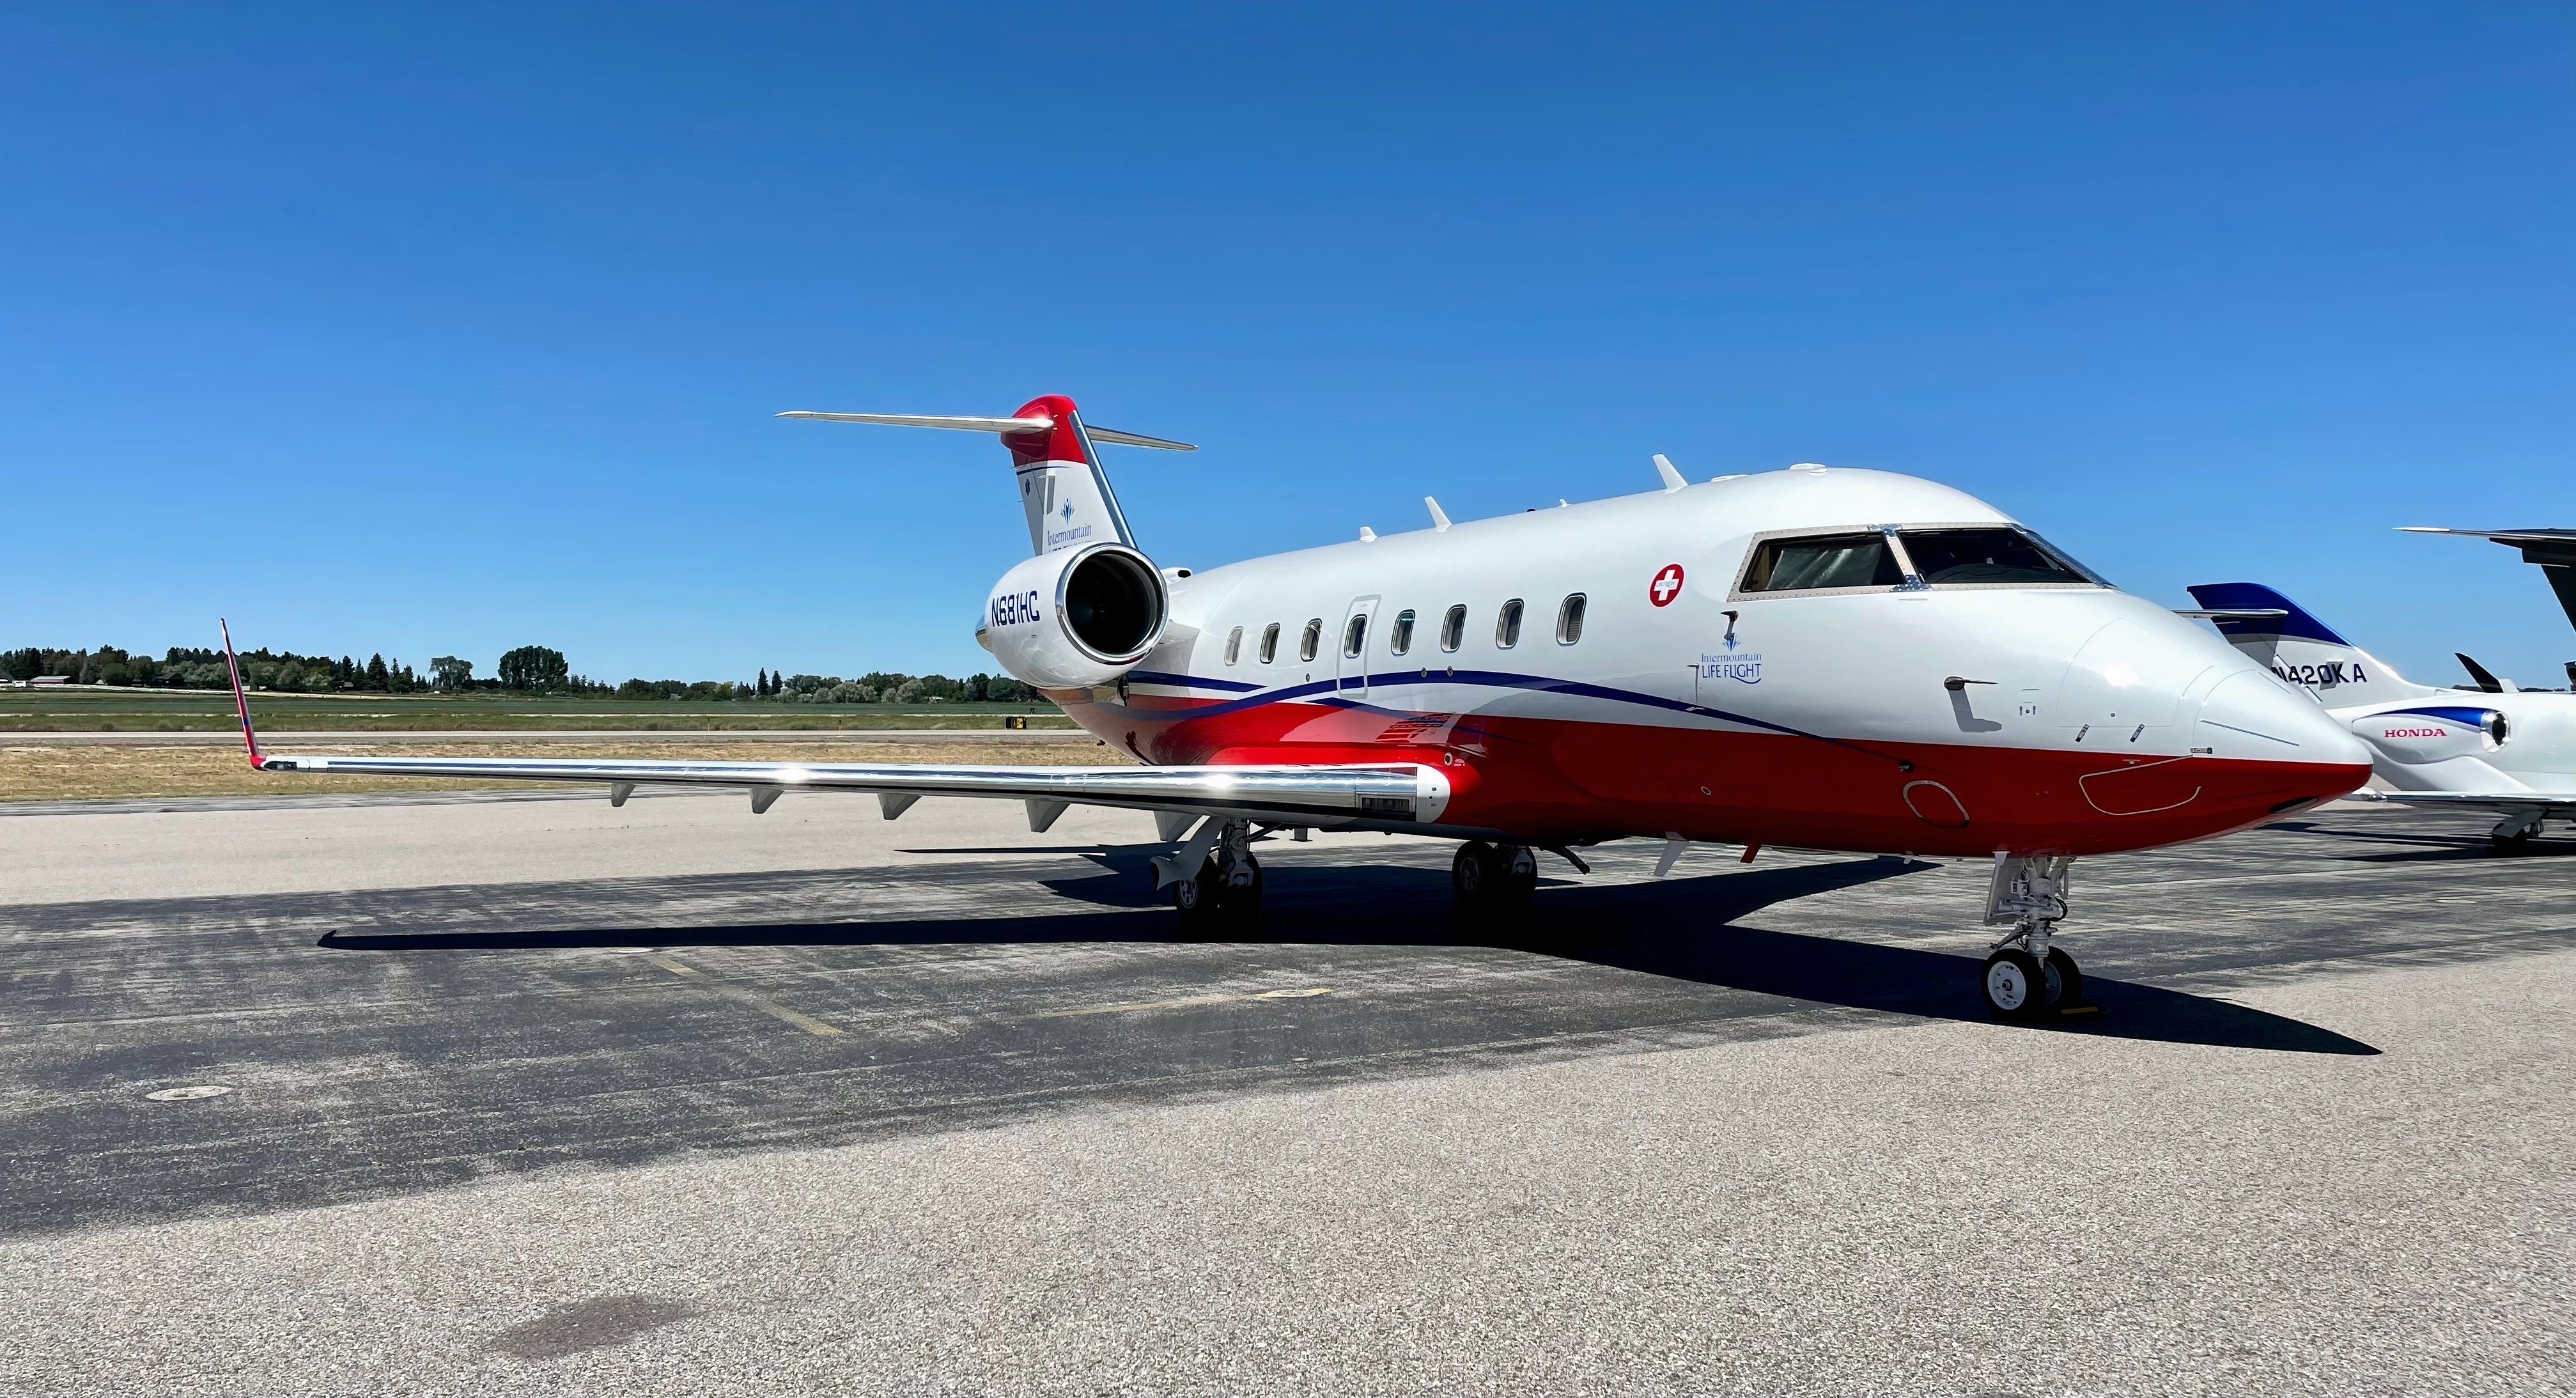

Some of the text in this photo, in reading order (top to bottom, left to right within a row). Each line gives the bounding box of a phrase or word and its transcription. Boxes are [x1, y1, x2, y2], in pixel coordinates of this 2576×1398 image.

[1048, 523, 1092, 546] Intermountain
[991, 590, 1041, 627] N681HC
[1702, 653, 1762, 663] Intermountain
[1702, 664, 1762, 684] LIFE FLIGHT
[2384, 728, 2448, 738] HONDA
